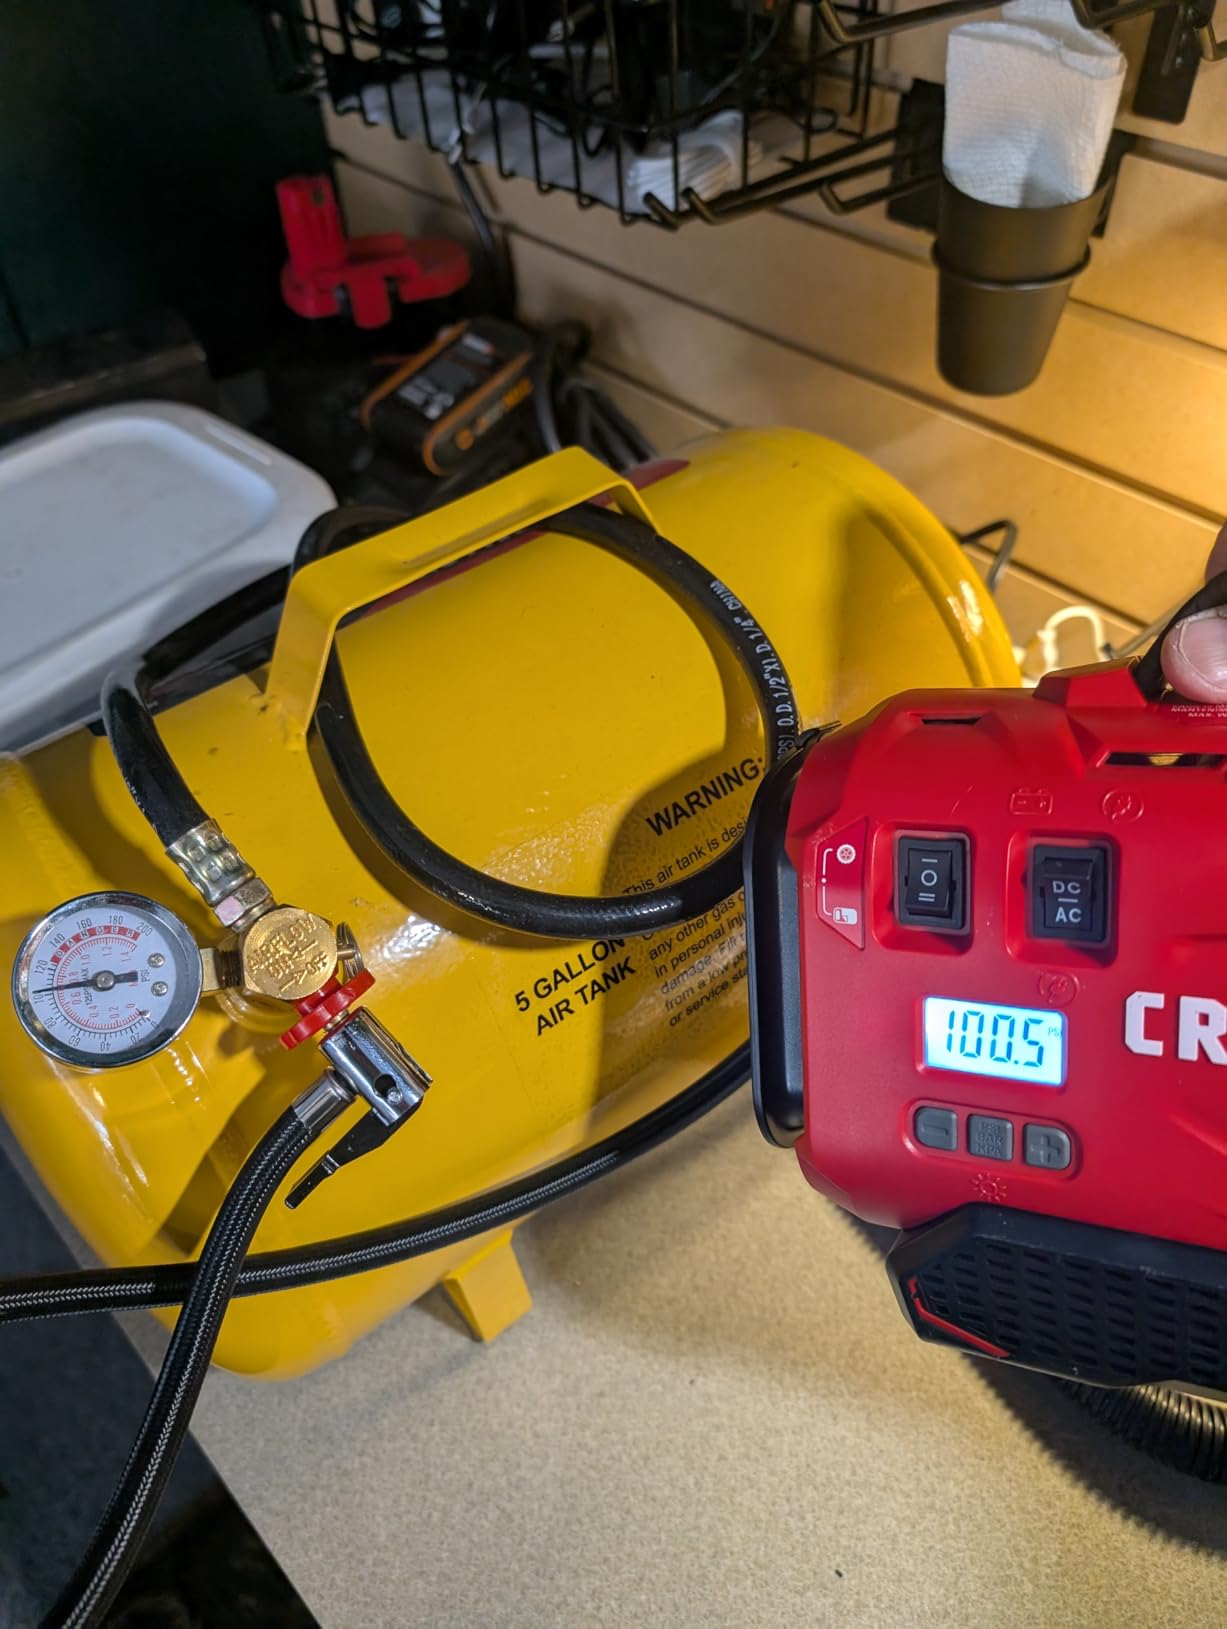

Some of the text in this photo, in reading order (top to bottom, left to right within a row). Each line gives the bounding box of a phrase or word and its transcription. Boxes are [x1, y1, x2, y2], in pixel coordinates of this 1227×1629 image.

[709, 579, 742, 611] CHINA
[645, 757, 766, 837] WARNING:
[656, 863, 675, 885] air
[675, 844, 707, 870] tank
[706, 837, 720, 852] is
[1052, 880, 1081, 895] DC
[109, 915, 123, 925] 180
[1055, 906, 1083, 924] AC
[76, 918, 92, 930] 160
[136, 921, 152, 936] 200
[649, 937, 673, 961] any
[676, 915, 709, 943] other
[712, 898, 736, 920] gas
[50, 933, 66, 948] 140
[247, 911, 318, 975] AIRFLOW
[101, 945, 113, 957] 1.2
[119, 951, 131, 963] 1.4
[655, 963, 668, 979] in
[670, 926, 725, 972] personal
[34, 959, 48, 974] 120
[80, 954, 91, 966] 1.0
[305, 951, 329, 976] OFF
[140, 969, 151, 983] PSI
[515, 939, 625, 1012] 5 GALLON
[664, 984, 695, 1012] from
[697, 977, 707, 990] a
[708, 960, 729, 981] low
[71, 991, 81, 1005] 0.6
[537, 955, 636, 1036] AIR TANK
[669, 1009, 683, 1027] or
[685, 980, 729, 1017] service
[108, 1006, 119, 1019] 0.2
[44, 1017, 57, 1029] 80
[1125, 990, 1227, 1066] CR
[68, 1034, 81, 1047] 60
[130, 1032, 140, 1045] 20
[946, 1010, 1044, 1068] 100.5
[100, 1041, 111, 1052] 40
[975, 1132, 1003, 1145] BAR
